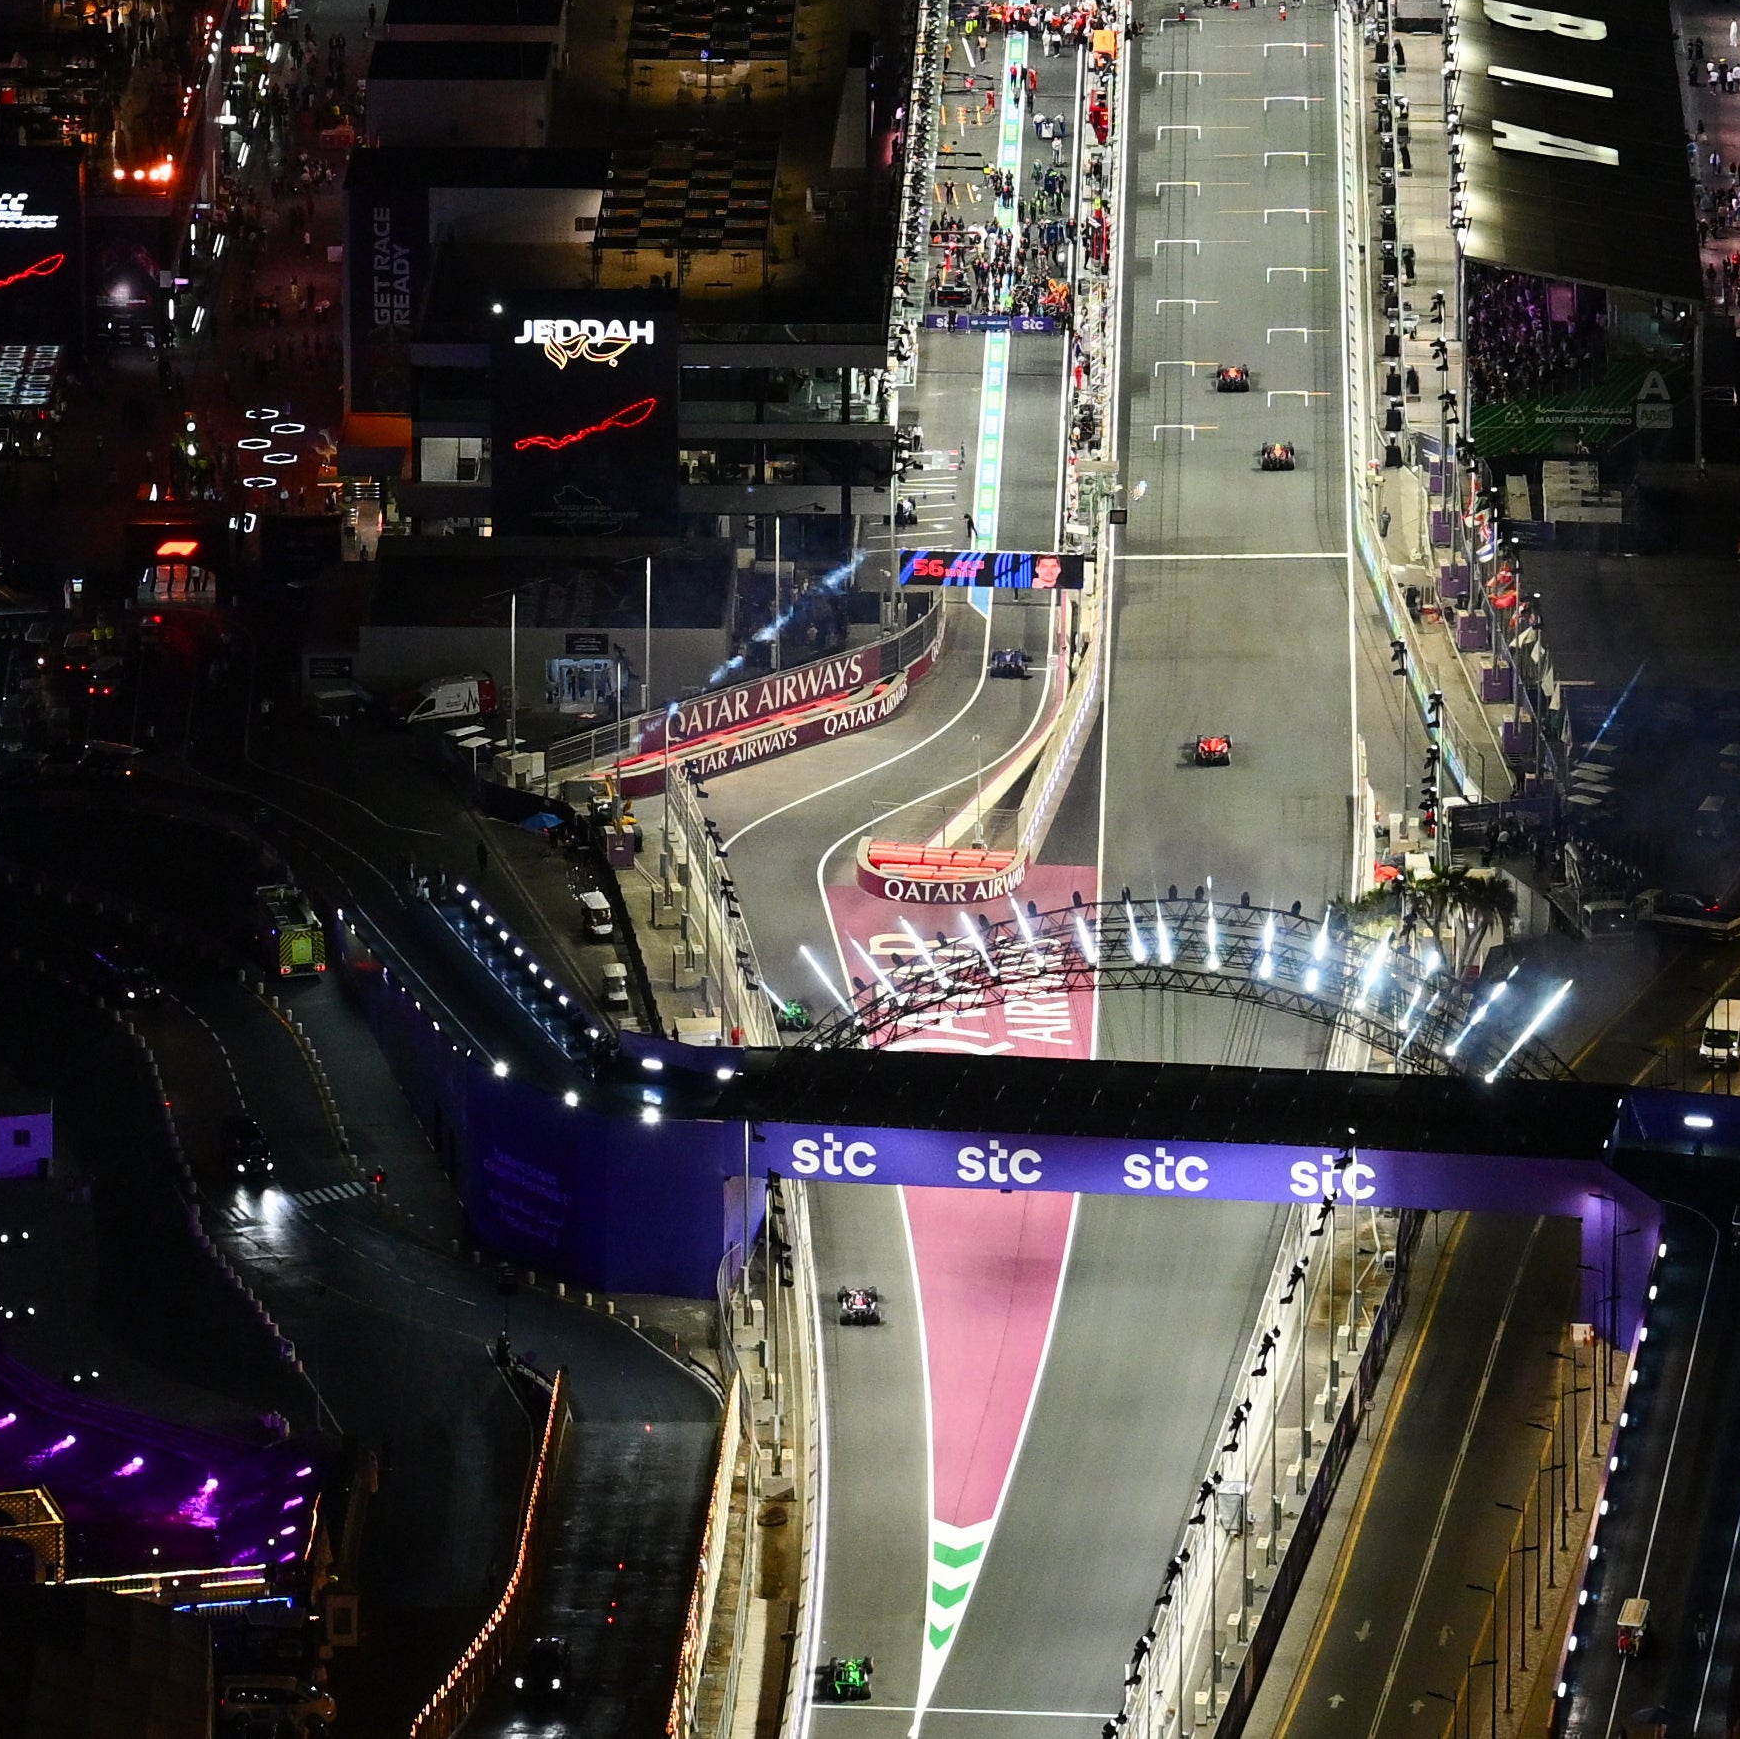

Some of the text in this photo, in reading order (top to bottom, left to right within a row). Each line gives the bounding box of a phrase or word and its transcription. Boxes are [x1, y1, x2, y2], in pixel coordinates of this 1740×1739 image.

[374, 207, 391, 325] GET RACE
[393, 244, 410, 325] READY
[514, 319, 654, 344] JEDDAH
[1023, 319, 1044, 331] stc
[1637, 371, 1671, 400] A
[1535, 417, 1633, 426] MAIN GRANDSTAND
[913, 558, 944, 576] 56
[756, 654, 864, 714] AIRWAYS
[824, 677, 909, 736] QATAR AIRWAYS
[731, 727, 797, 765] AIRWAYS
[884, 863, 1026, 901] QATAR AIRWAYS
[791, 1133, 877, 1178] stc
[957, 1140, 1042, 1185] stc
[1124, 1147, 1209, 1193] stc
[1290, 1154, 1376, 1202] stc
